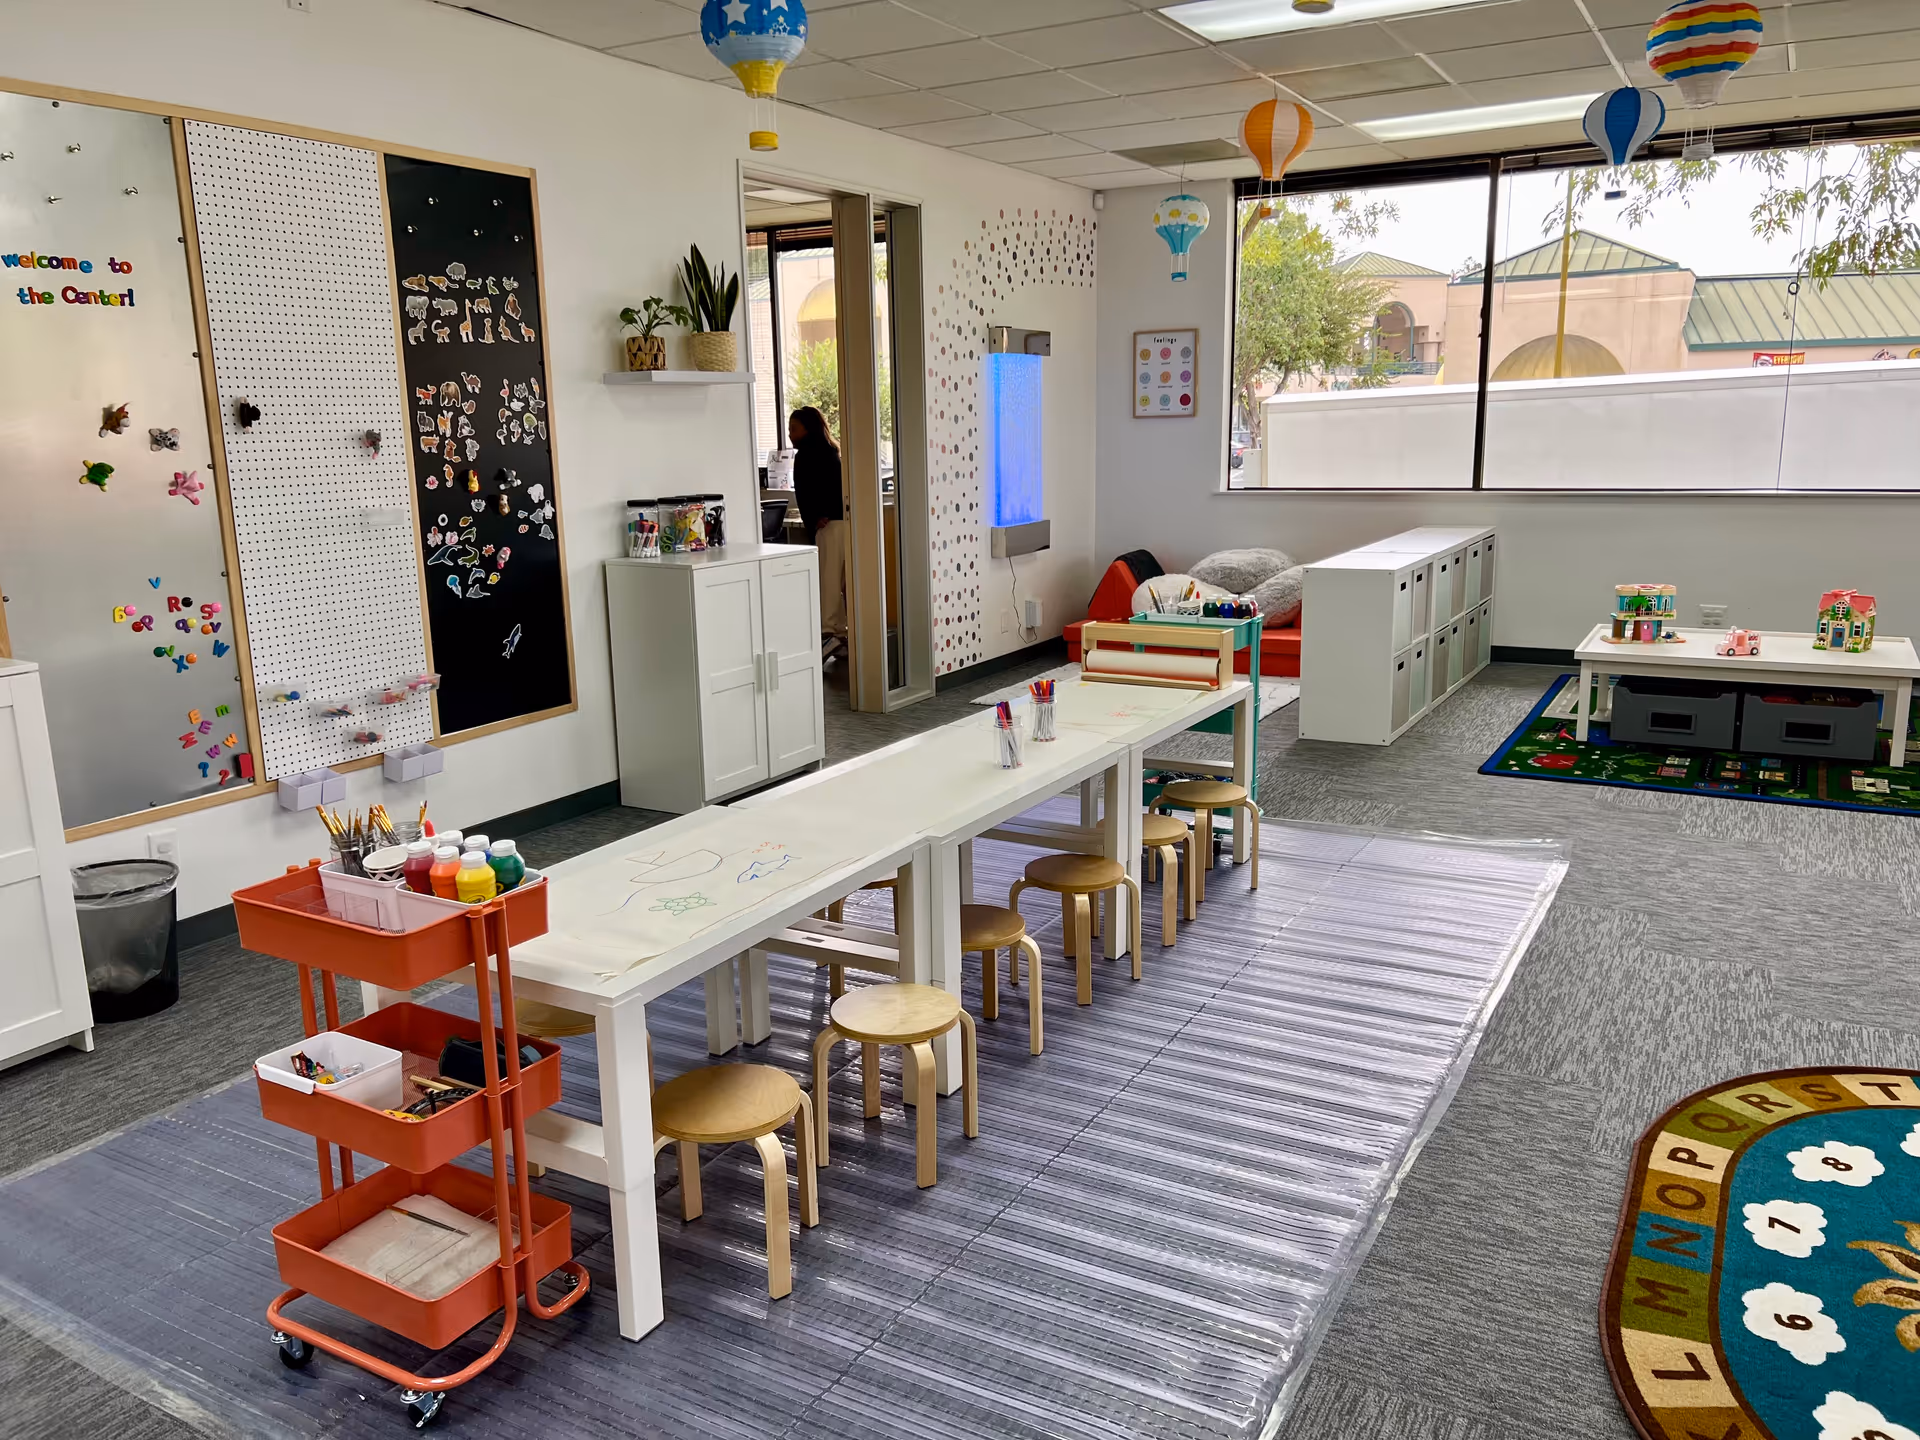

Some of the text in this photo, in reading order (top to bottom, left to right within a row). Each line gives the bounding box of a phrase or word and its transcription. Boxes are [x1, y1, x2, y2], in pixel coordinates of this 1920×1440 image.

[1, 251, 132, 274] welcome to
[17, 286, 135, 306] the Center!
[167, 596, 182, 612] R
[1801, 1083, 1843, 1103] S
[1859, 1082, 1902, 1101] T
[1735, 1093, 1793, 1114] R
[1691, 1112, 1750, 1134] Q
[1667, 1146, 1715, 1171] P
[1821, 1156, 1853, 1172] 8
[1655, 1183, 1706, 1211] O
[1767, 1216, 1801, 1234] 7
[1646, 1223, 1703, 1259] N
[1633, 1276, 1689, 1318] M
[1773, 1312, 1813, 1331] 6
[1651, 1351, 1712, 1382] L
